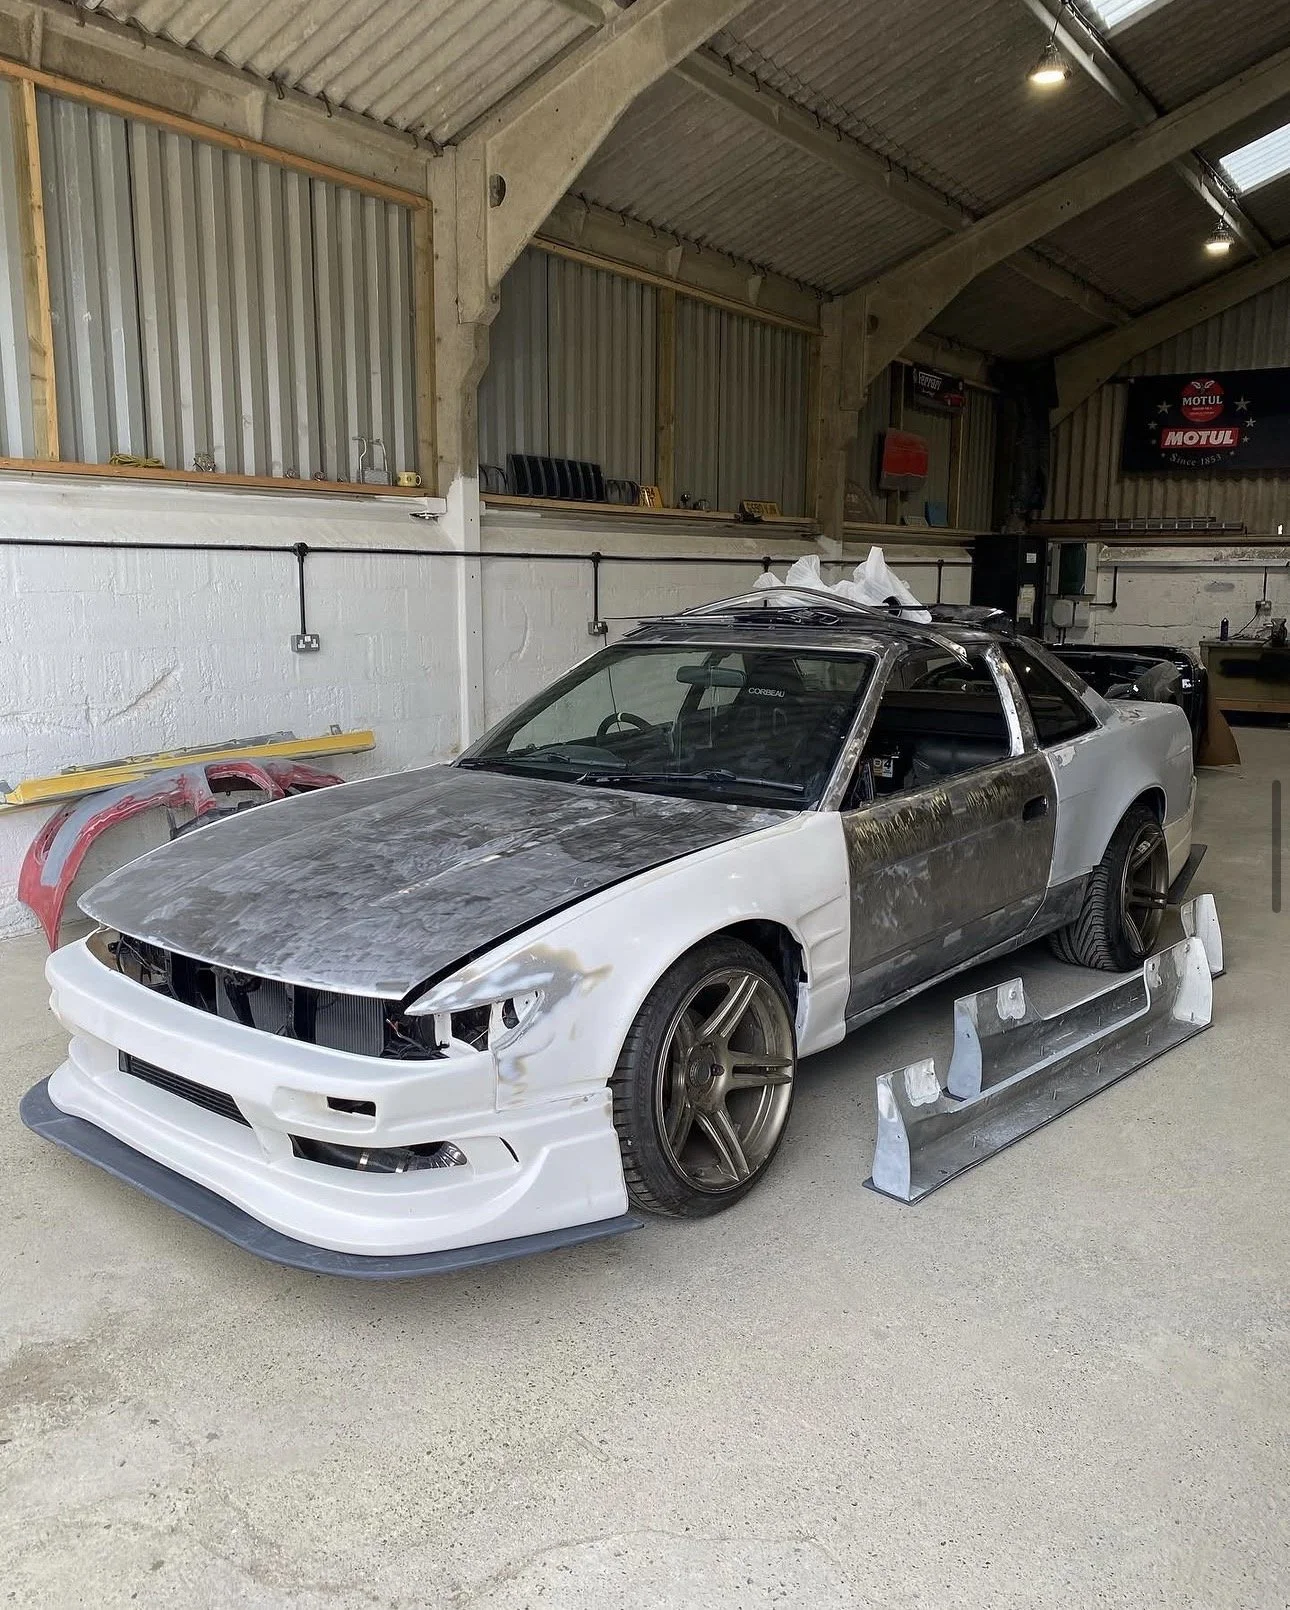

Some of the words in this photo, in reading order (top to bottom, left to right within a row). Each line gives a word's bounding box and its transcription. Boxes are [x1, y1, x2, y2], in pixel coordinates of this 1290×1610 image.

[1182, 395, 1223, 406] MOTUL
[1164, 430, 1234, 446] MOTUL
[1169, 452, 1196, 466] Since
[748, 687, 785, 698] CORBEAU
